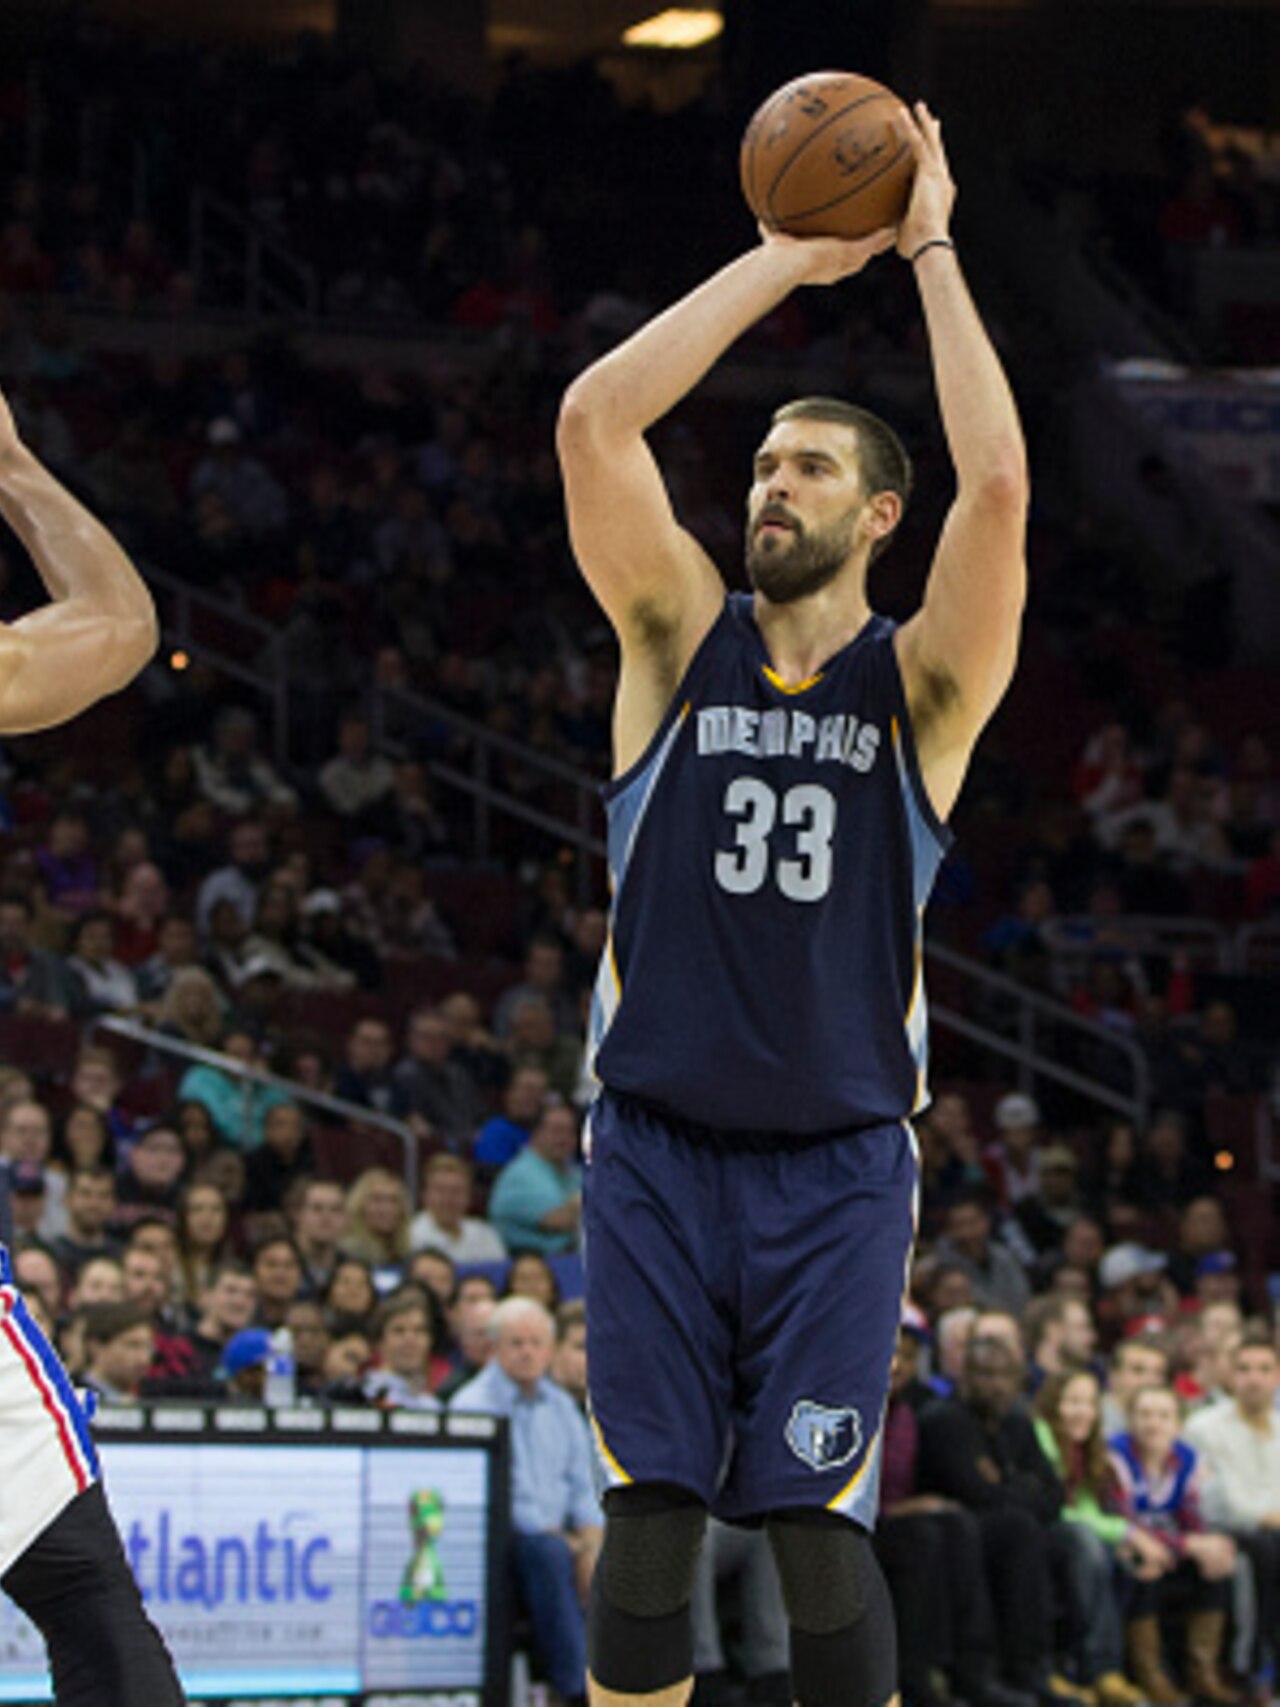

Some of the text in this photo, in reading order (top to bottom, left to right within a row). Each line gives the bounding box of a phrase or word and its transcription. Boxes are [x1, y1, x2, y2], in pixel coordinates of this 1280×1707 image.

[697, 705, 881, 773] MEMPHIS
[714, 777, 836, 902] 33
[127, 1510, 332, 1607] tlantic
